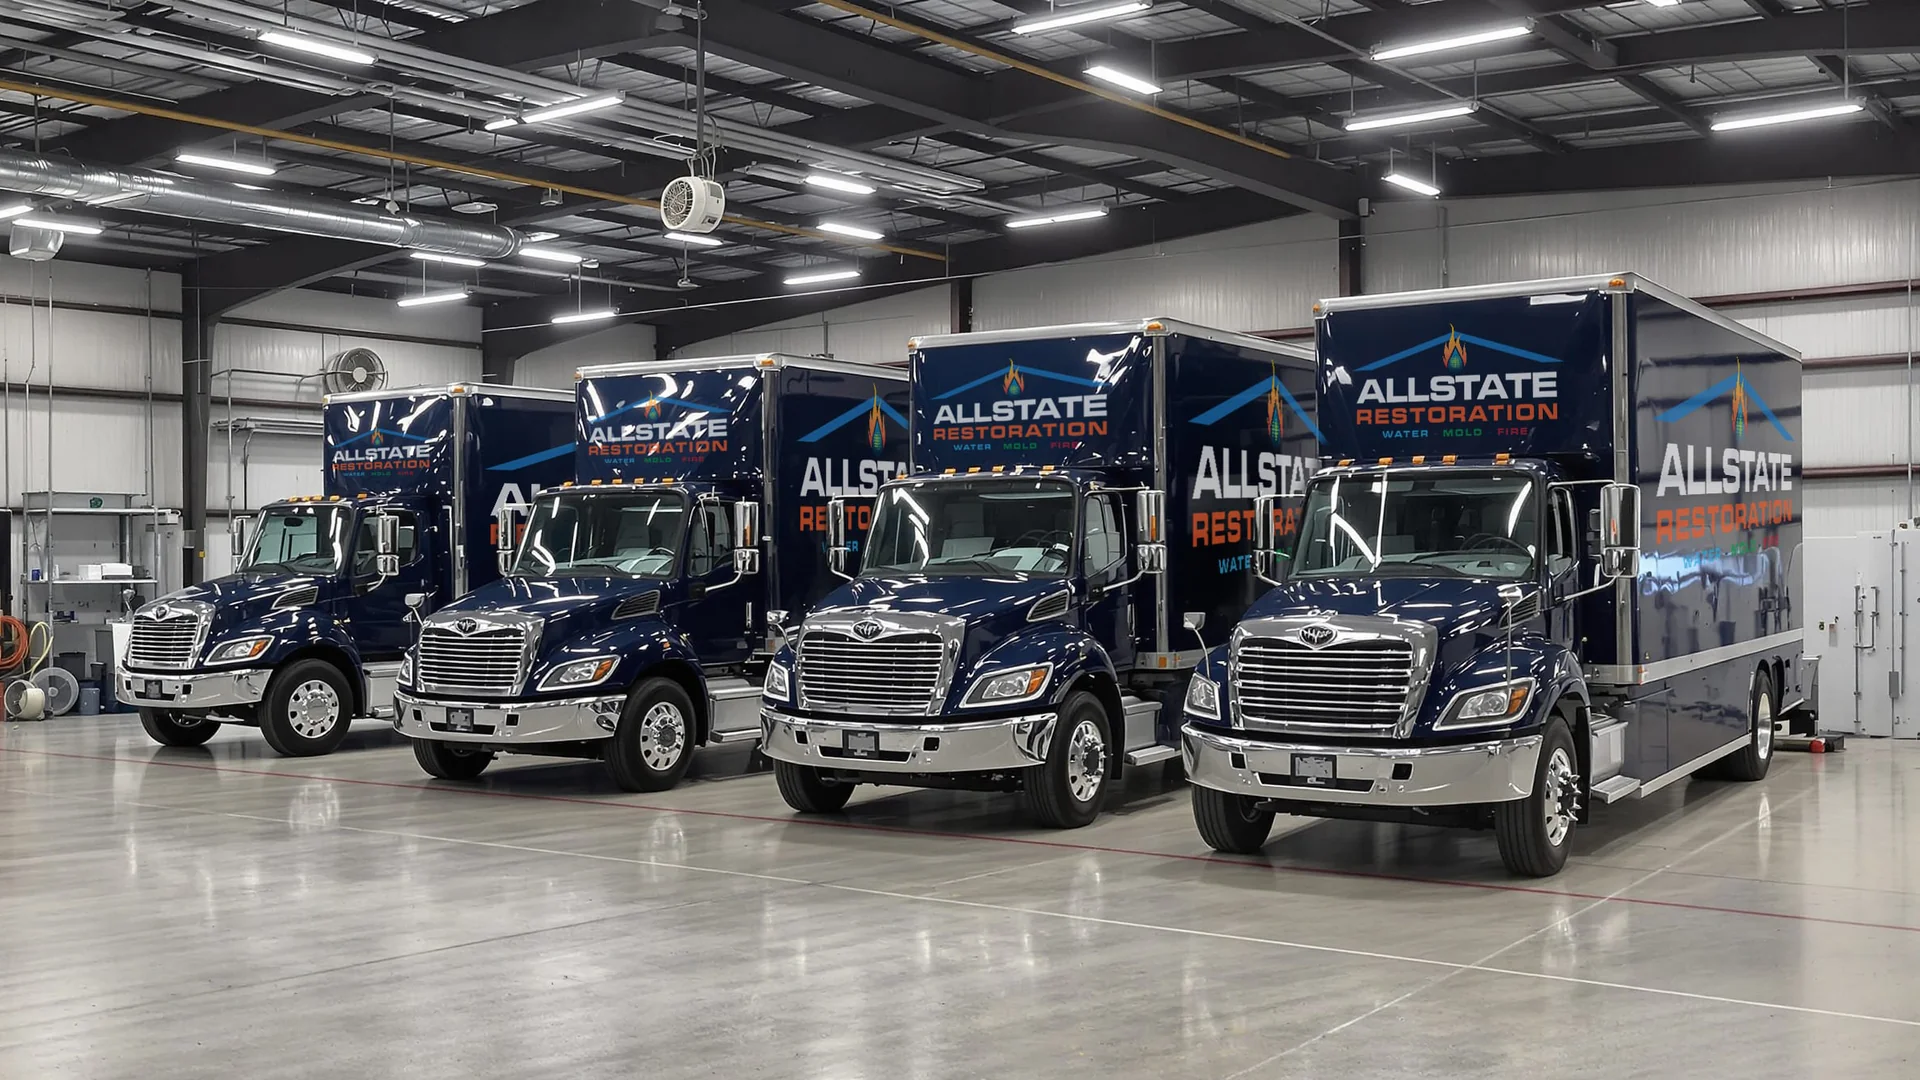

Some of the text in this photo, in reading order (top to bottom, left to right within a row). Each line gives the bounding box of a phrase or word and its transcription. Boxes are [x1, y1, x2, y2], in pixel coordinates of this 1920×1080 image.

[1356, 371, 1558, 404] ALLSTATE
[933, 394, 1108, 425] ALLSTATE
[1356, 403, 1559, 425] RESTORATION
[588, 418, 728, 443] ALLSTATE
[933, 421, 1108, 441] RESTORATION
[1382, 427, 1528, 438] WATER MOLD FIRE
[332, 444, 431, 462] ALLSTATE
[588, 440, 728, 456] RESTORATION
[953, 443, 991, 451] WATER
[1003, 442, 1037, 450] MOLD
[331, 460, 431, 471] RESTORATION
[1656, 443, 1793, 498] ALLSTATE
[1656, 499, 1793, 545] RESTORATION
[1218, 554, 1251, 575] WATE
